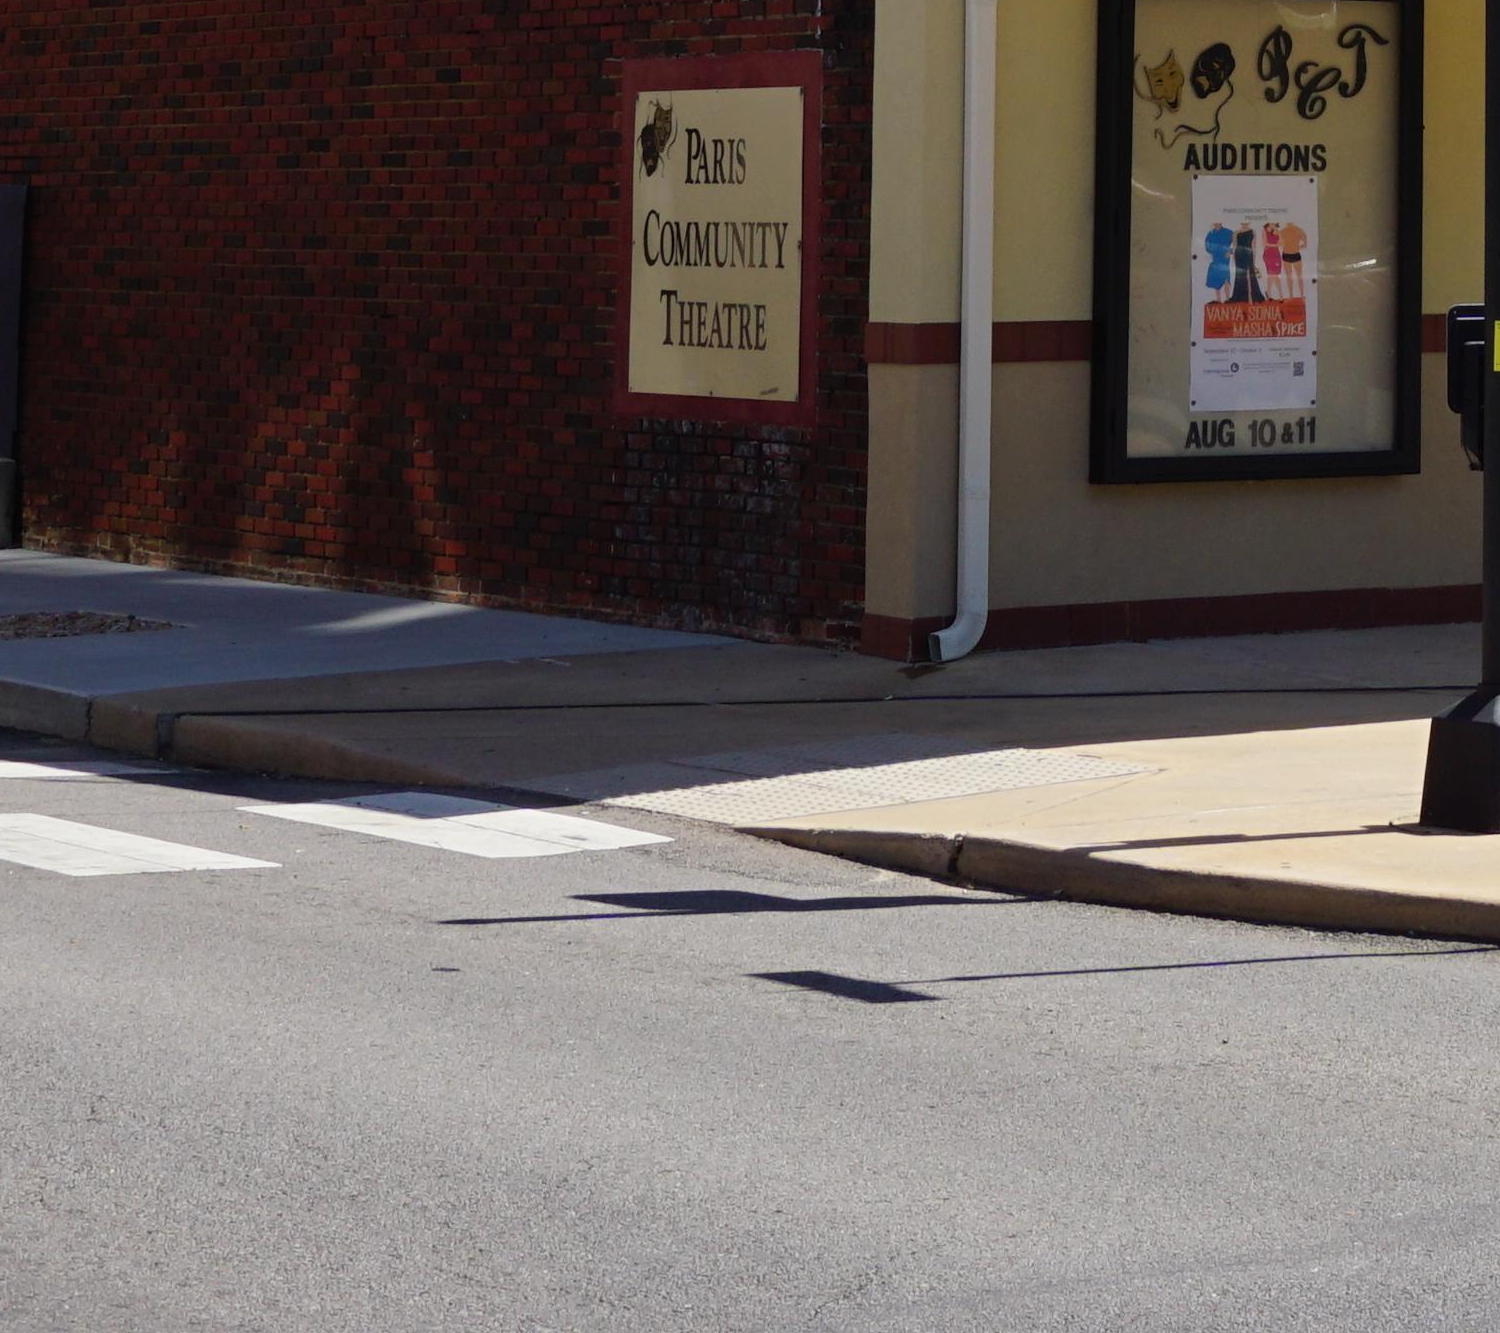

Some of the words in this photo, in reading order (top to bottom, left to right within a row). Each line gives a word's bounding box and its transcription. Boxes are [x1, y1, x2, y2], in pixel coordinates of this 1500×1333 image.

[684, 127, 746, 185] PARIS
[1184, 143, 1328, 173] AUDITIONS
[643, 209, 788, 269] COMMUNITY
[660, 289, 767, 351] THEATRE
[1207, 305, 1244, 322] VANYA
[1248, 304, 1282, 320] SONIA
[1233, 321, 1273, 337] MASHA
[1275, 320, 1305, 338] SPIKE
[1185, 418, 1236, 450] AUG
